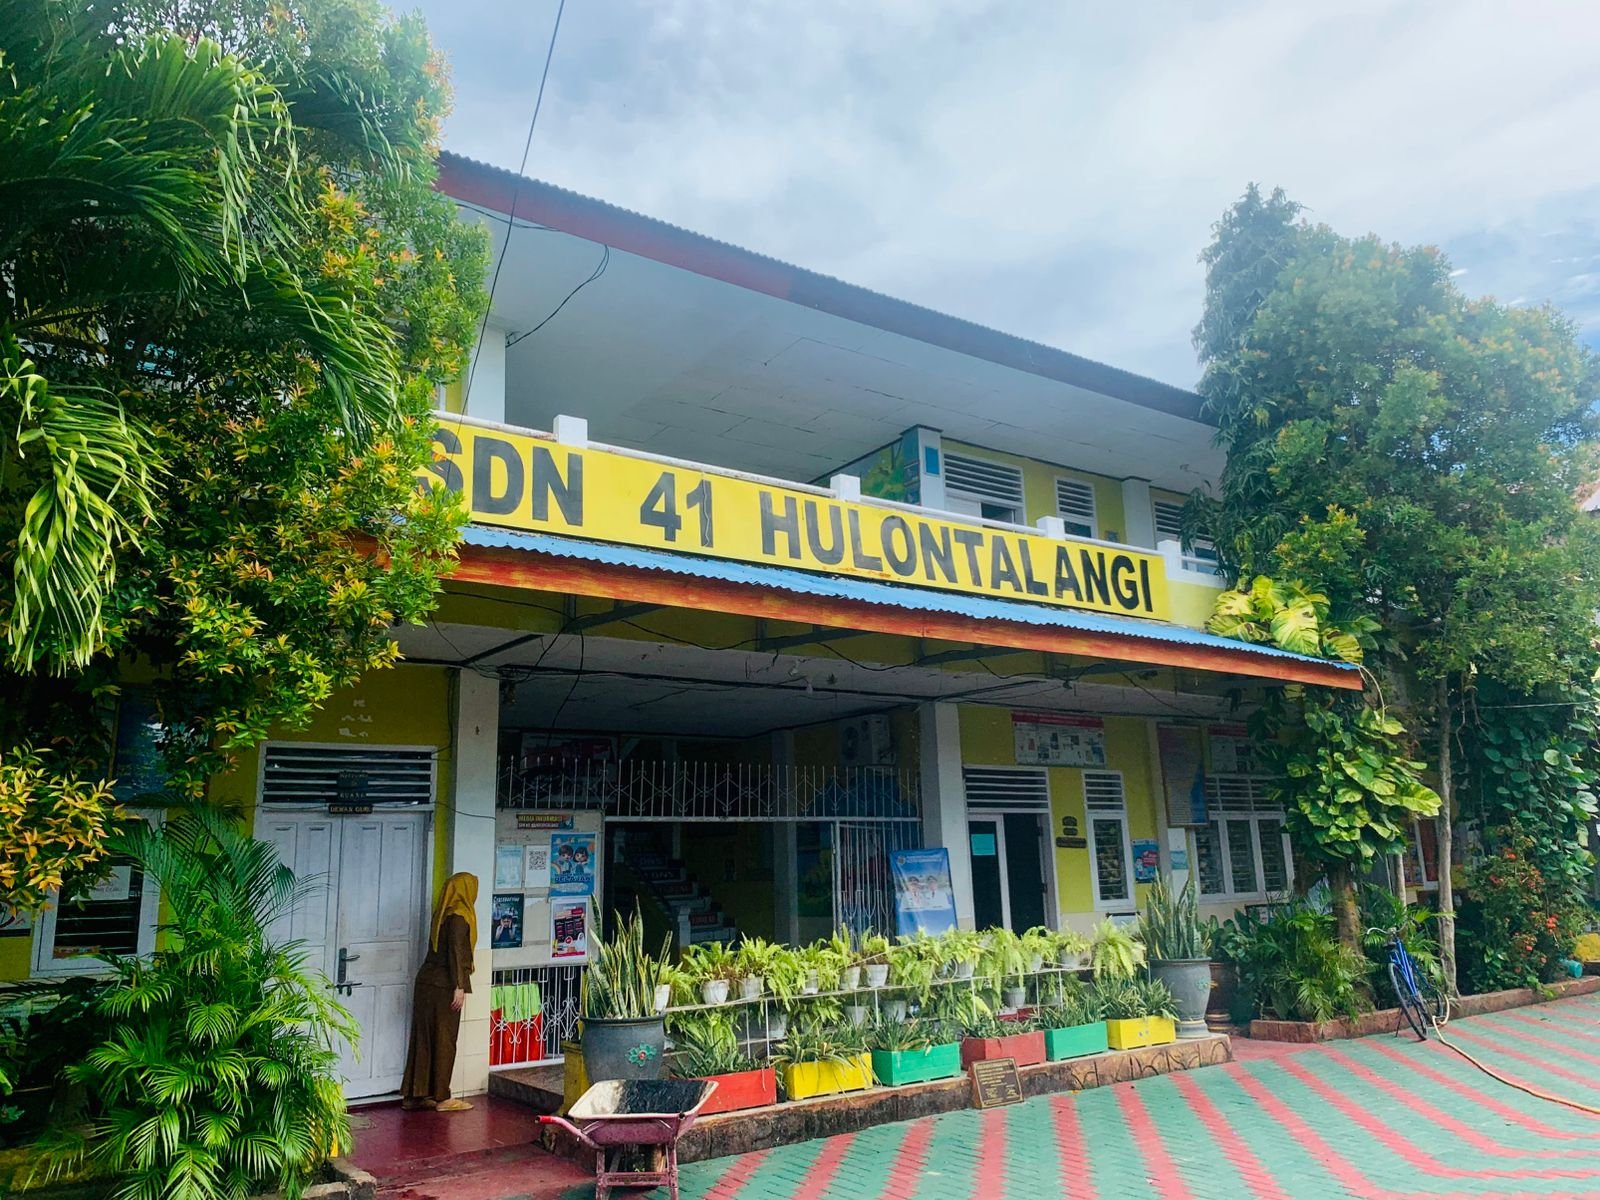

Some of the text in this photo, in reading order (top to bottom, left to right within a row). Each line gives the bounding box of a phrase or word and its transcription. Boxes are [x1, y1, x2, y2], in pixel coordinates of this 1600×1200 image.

[417, 428, 1153, 612] SDN 41 HULONTALANGI
